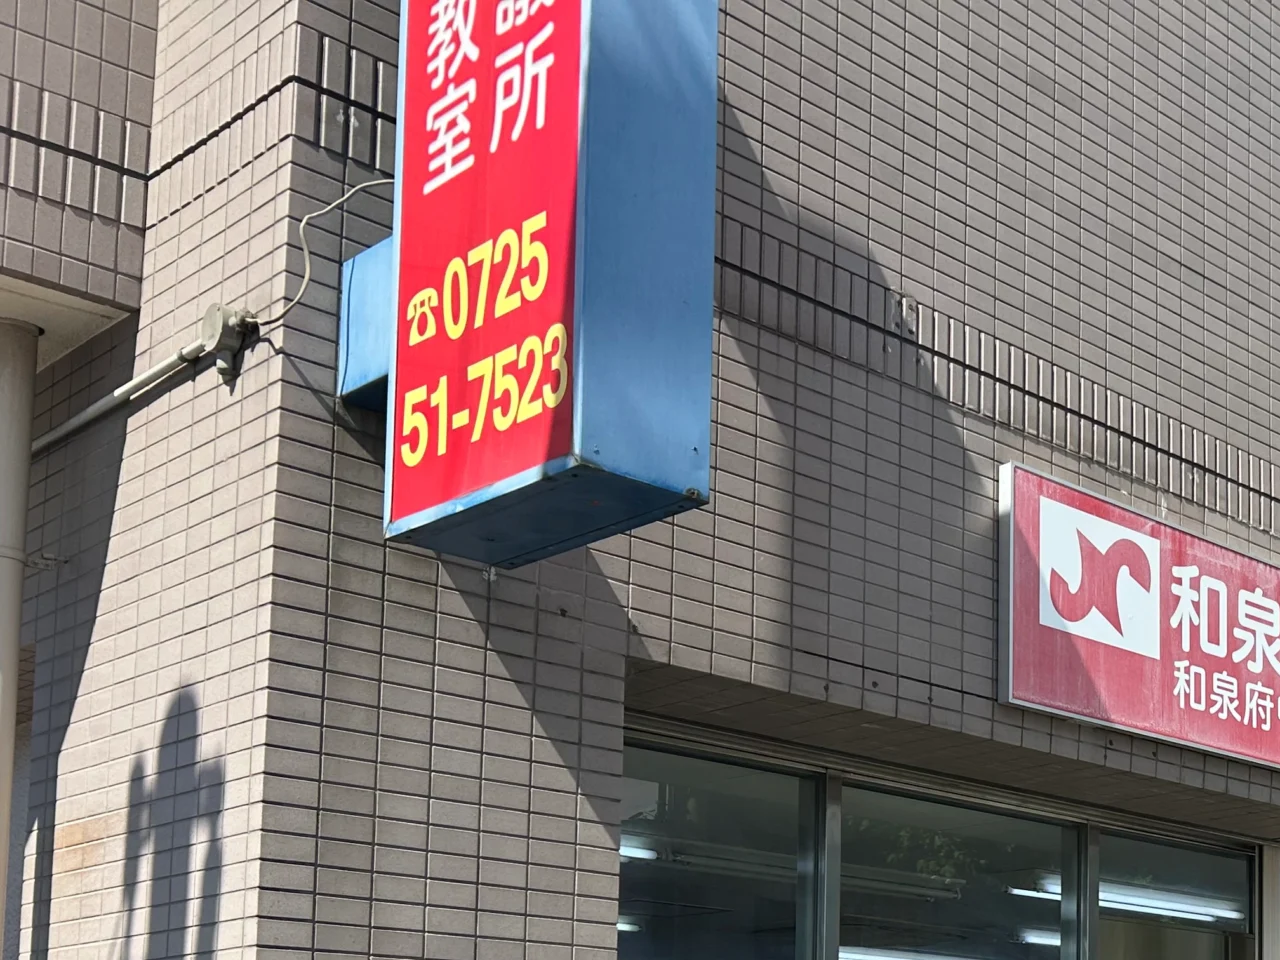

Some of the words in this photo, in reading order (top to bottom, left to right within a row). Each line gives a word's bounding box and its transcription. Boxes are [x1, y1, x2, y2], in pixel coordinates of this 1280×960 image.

[423, 0, 480, 195] 教室
[443, 211, 548, 341] 0725
[400, 322, 568, 468] 51-7523
